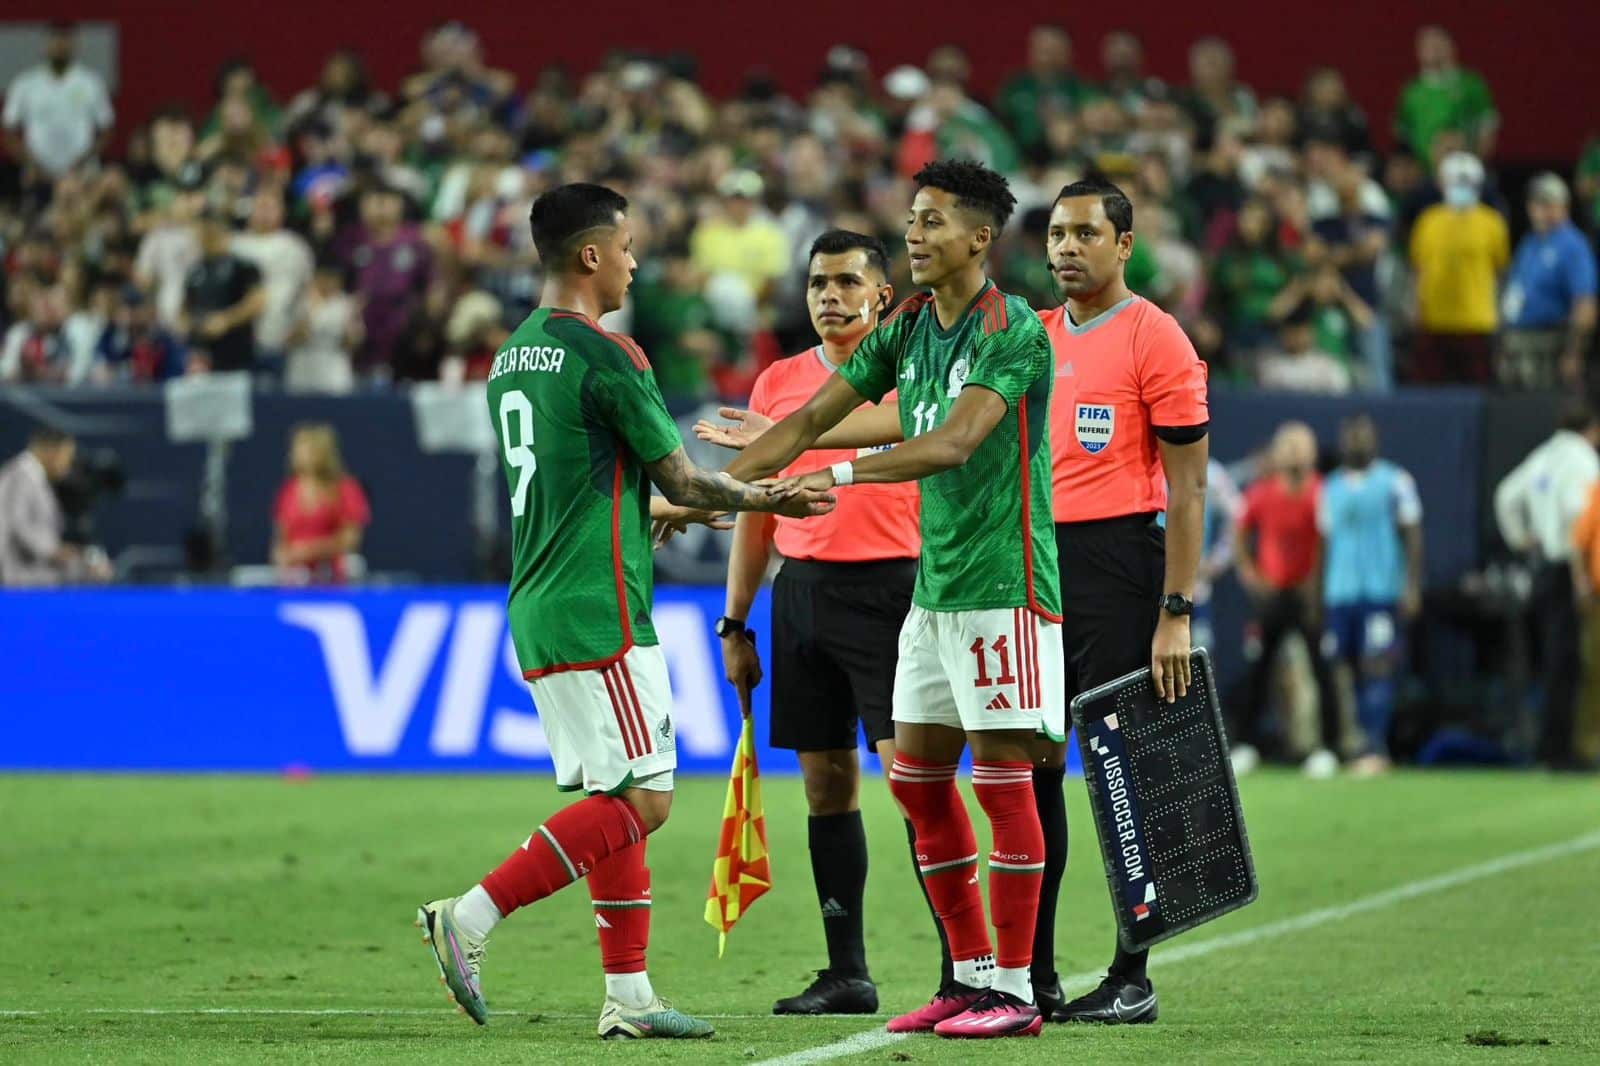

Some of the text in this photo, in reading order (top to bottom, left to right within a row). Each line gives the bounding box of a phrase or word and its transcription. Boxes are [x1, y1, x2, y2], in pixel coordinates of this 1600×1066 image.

[912, 401, 938, 437] 11
[1078, 426, 1110, 434] REFEREE
[1079, 407, 1110, 420] FIFA
[500, 390, 536, 517] 9
[969, 635, 1016, 687] 11
[1103, 755, 1145, 882] USSOCCER.COM
